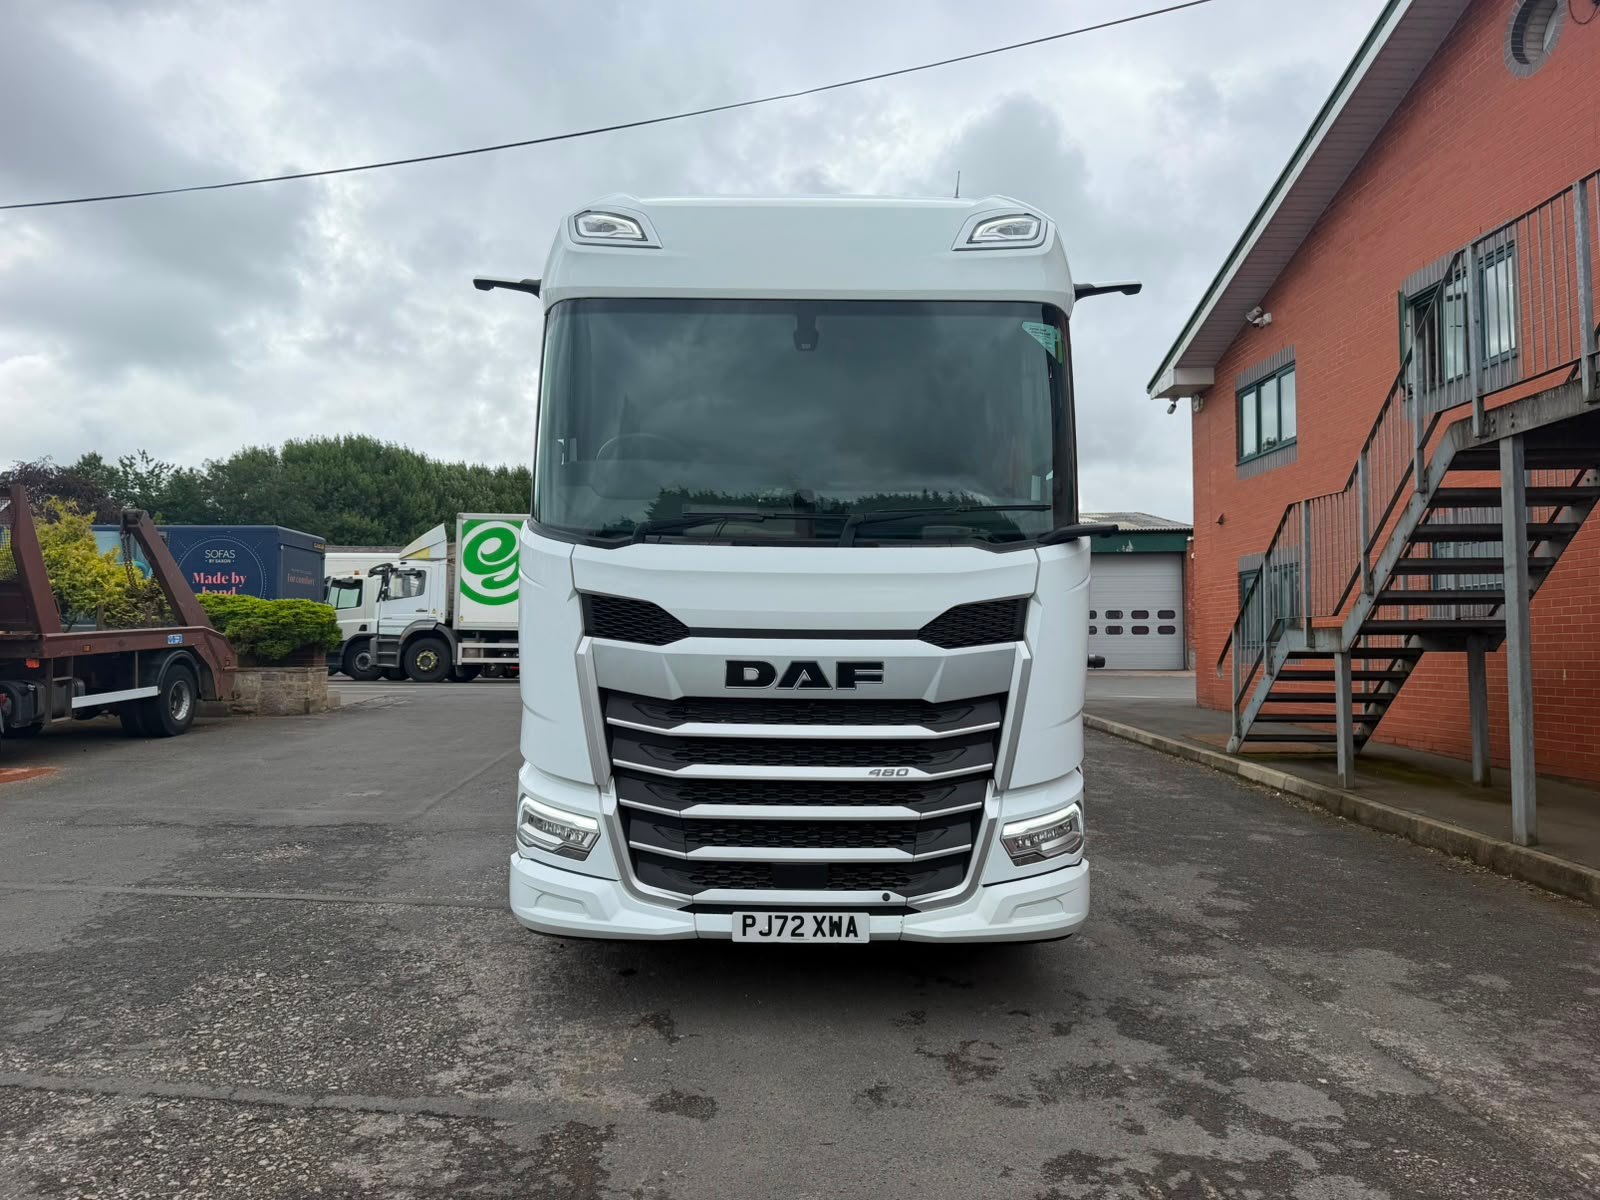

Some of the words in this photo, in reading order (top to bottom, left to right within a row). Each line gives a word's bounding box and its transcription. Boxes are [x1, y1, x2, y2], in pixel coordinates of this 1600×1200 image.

[204, 549, 236, 559] SOFAS
[192, 572, 229, 584] Made
[231, 572, 246, 587] by
[725, 659, 884, 690] DAF
[868, 768, 909, 777] 480
[741, 914, 805, 938] PJ72
[812, 915, 859, 938] XWA
